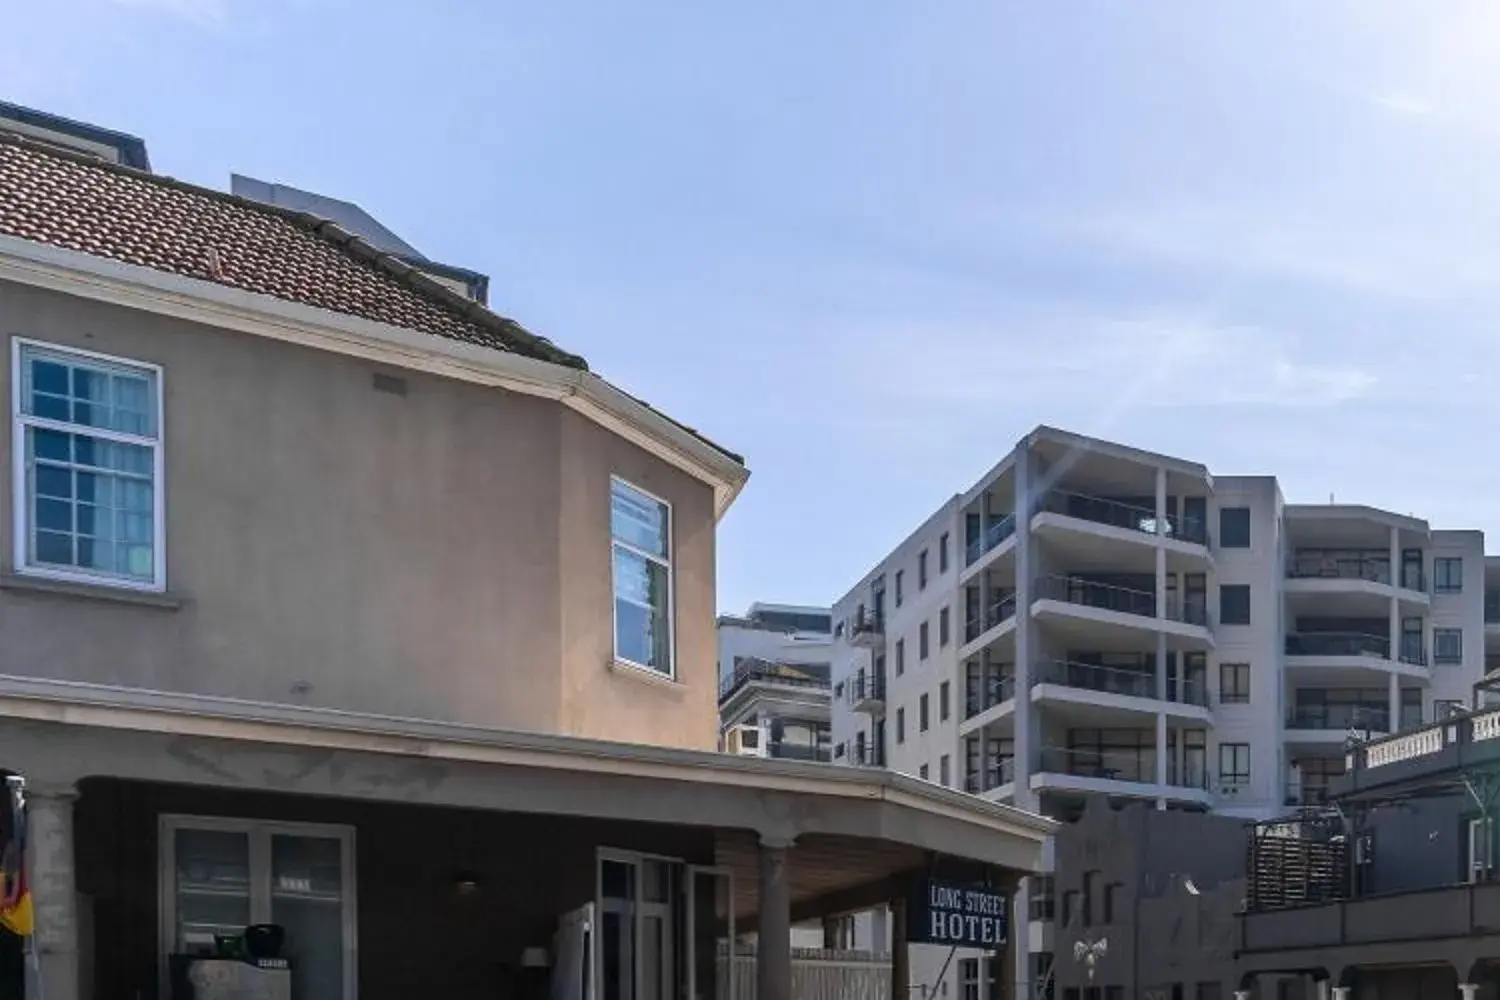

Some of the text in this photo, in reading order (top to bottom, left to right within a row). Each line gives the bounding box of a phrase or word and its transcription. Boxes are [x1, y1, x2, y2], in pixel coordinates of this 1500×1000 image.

[931, 884, 1005, 915] LONG STREET
[931, 911, 1007, 944] HOTEL
